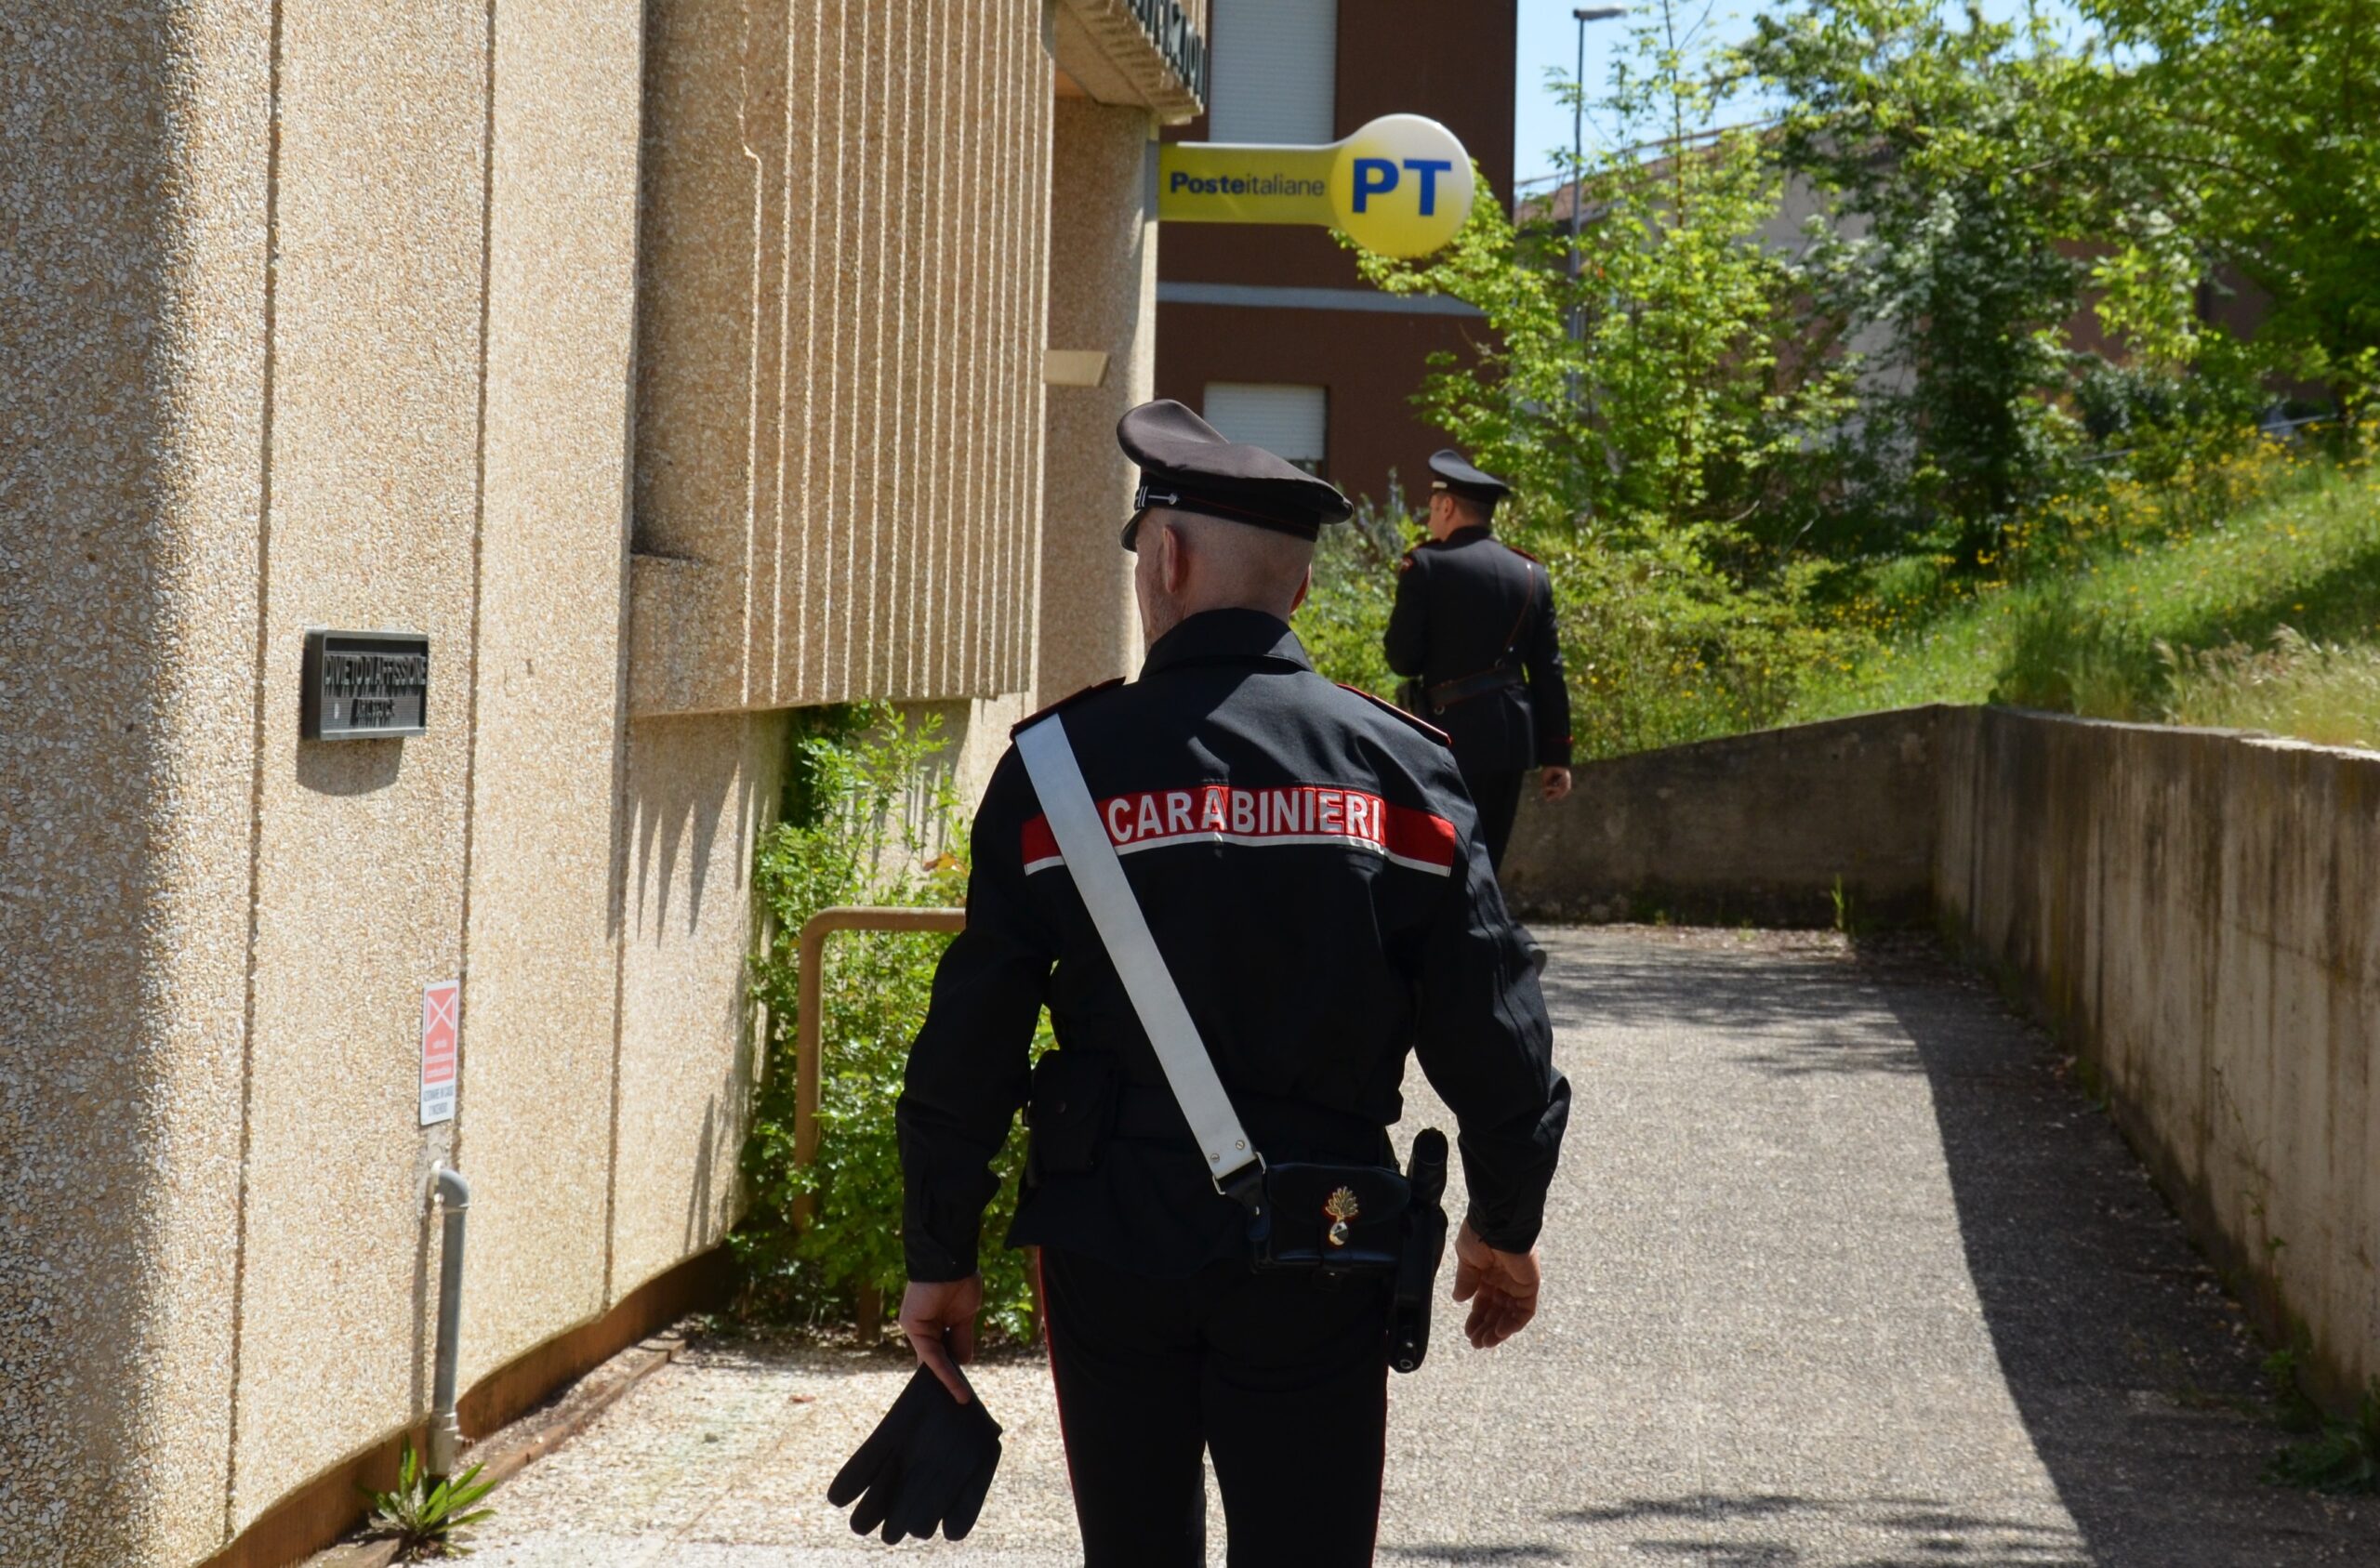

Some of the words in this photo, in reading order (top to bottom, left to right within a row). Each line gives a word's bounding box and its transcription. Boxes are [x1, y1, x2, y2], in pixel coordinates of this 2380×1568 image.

[1170, 172, 1325, 197] Posteitaliane
[1352, 158, 1451, 216] PT
[324, 654, 363, 685] DIVIETO
[364, 654, 375, 685] DI
[376, 655, 427, 685] AFFISSIONE
[1107, 787, 1381, 842] CARABINIERI
